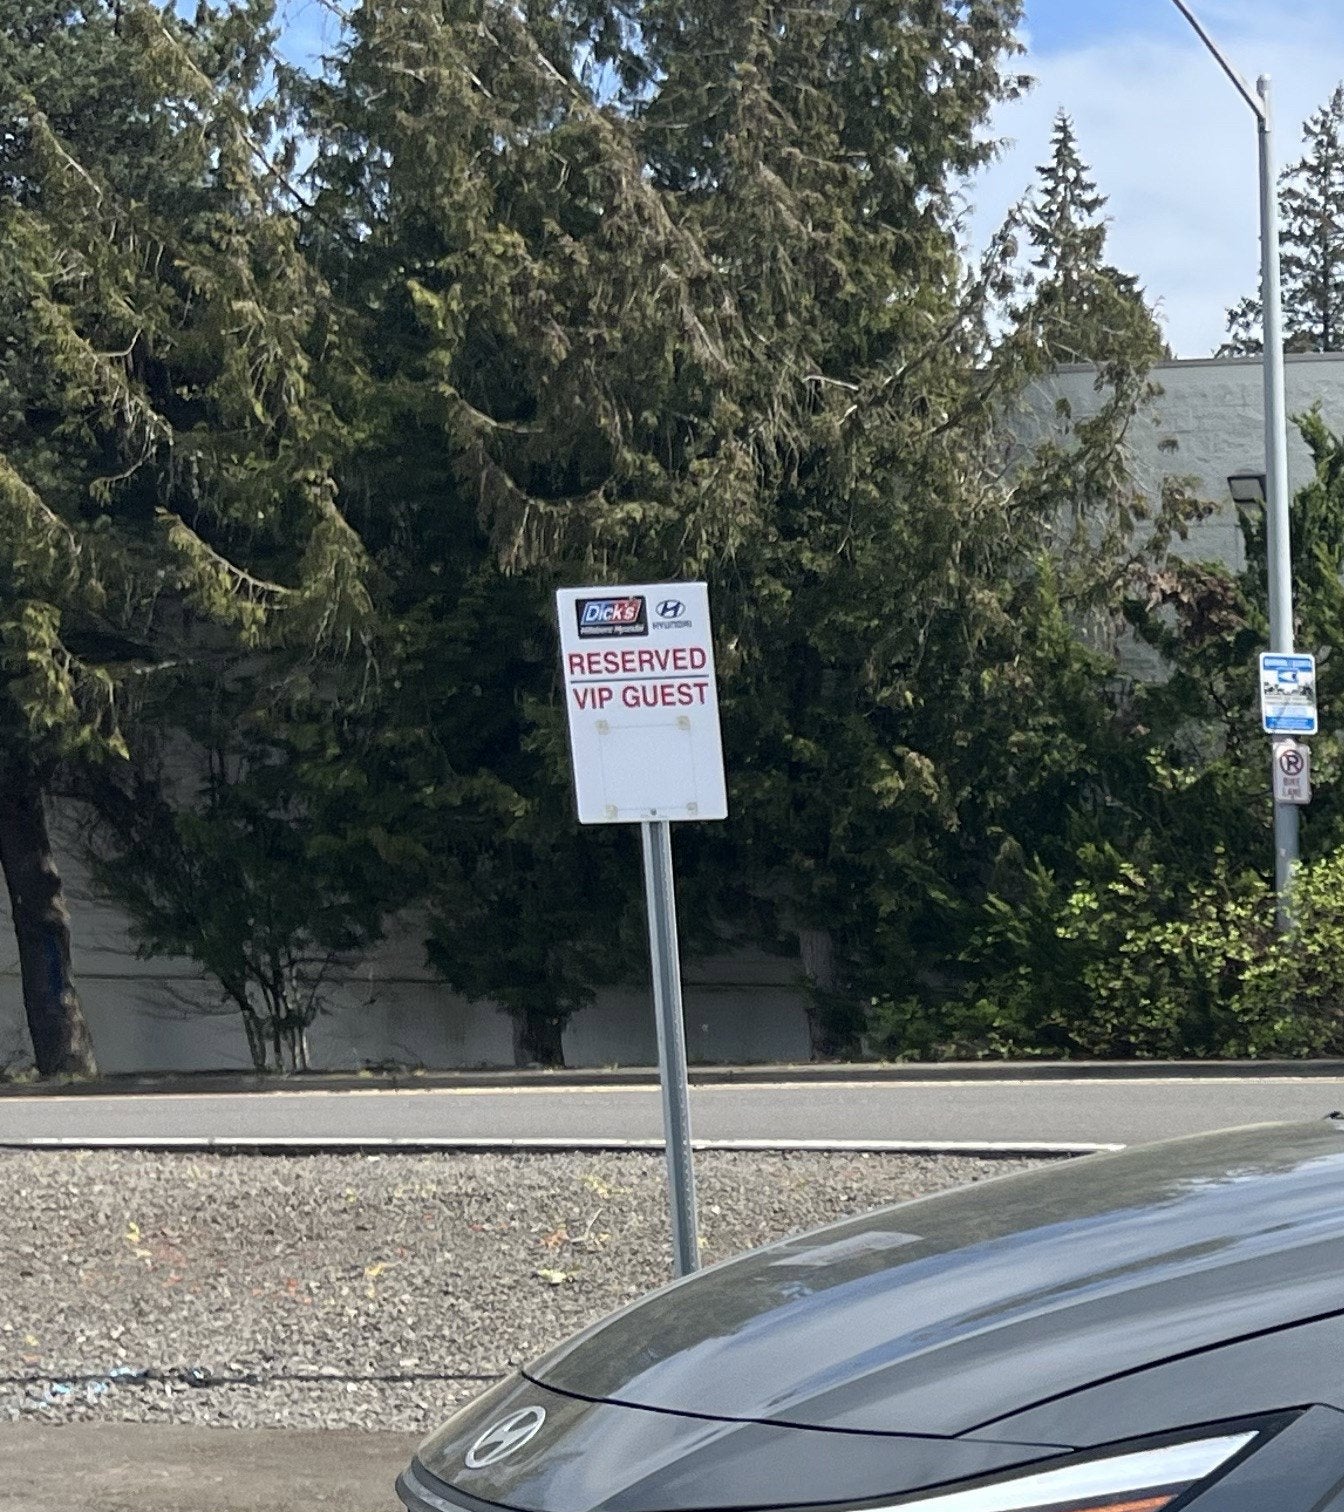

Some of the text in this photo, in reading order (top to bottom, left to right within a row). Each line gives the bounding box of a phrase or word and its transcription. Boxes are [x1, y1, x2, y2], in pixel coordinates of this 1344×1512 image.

[568, 647, 707, 675] RESERVED
[573, 683, 709, 710] VIP GUEST
